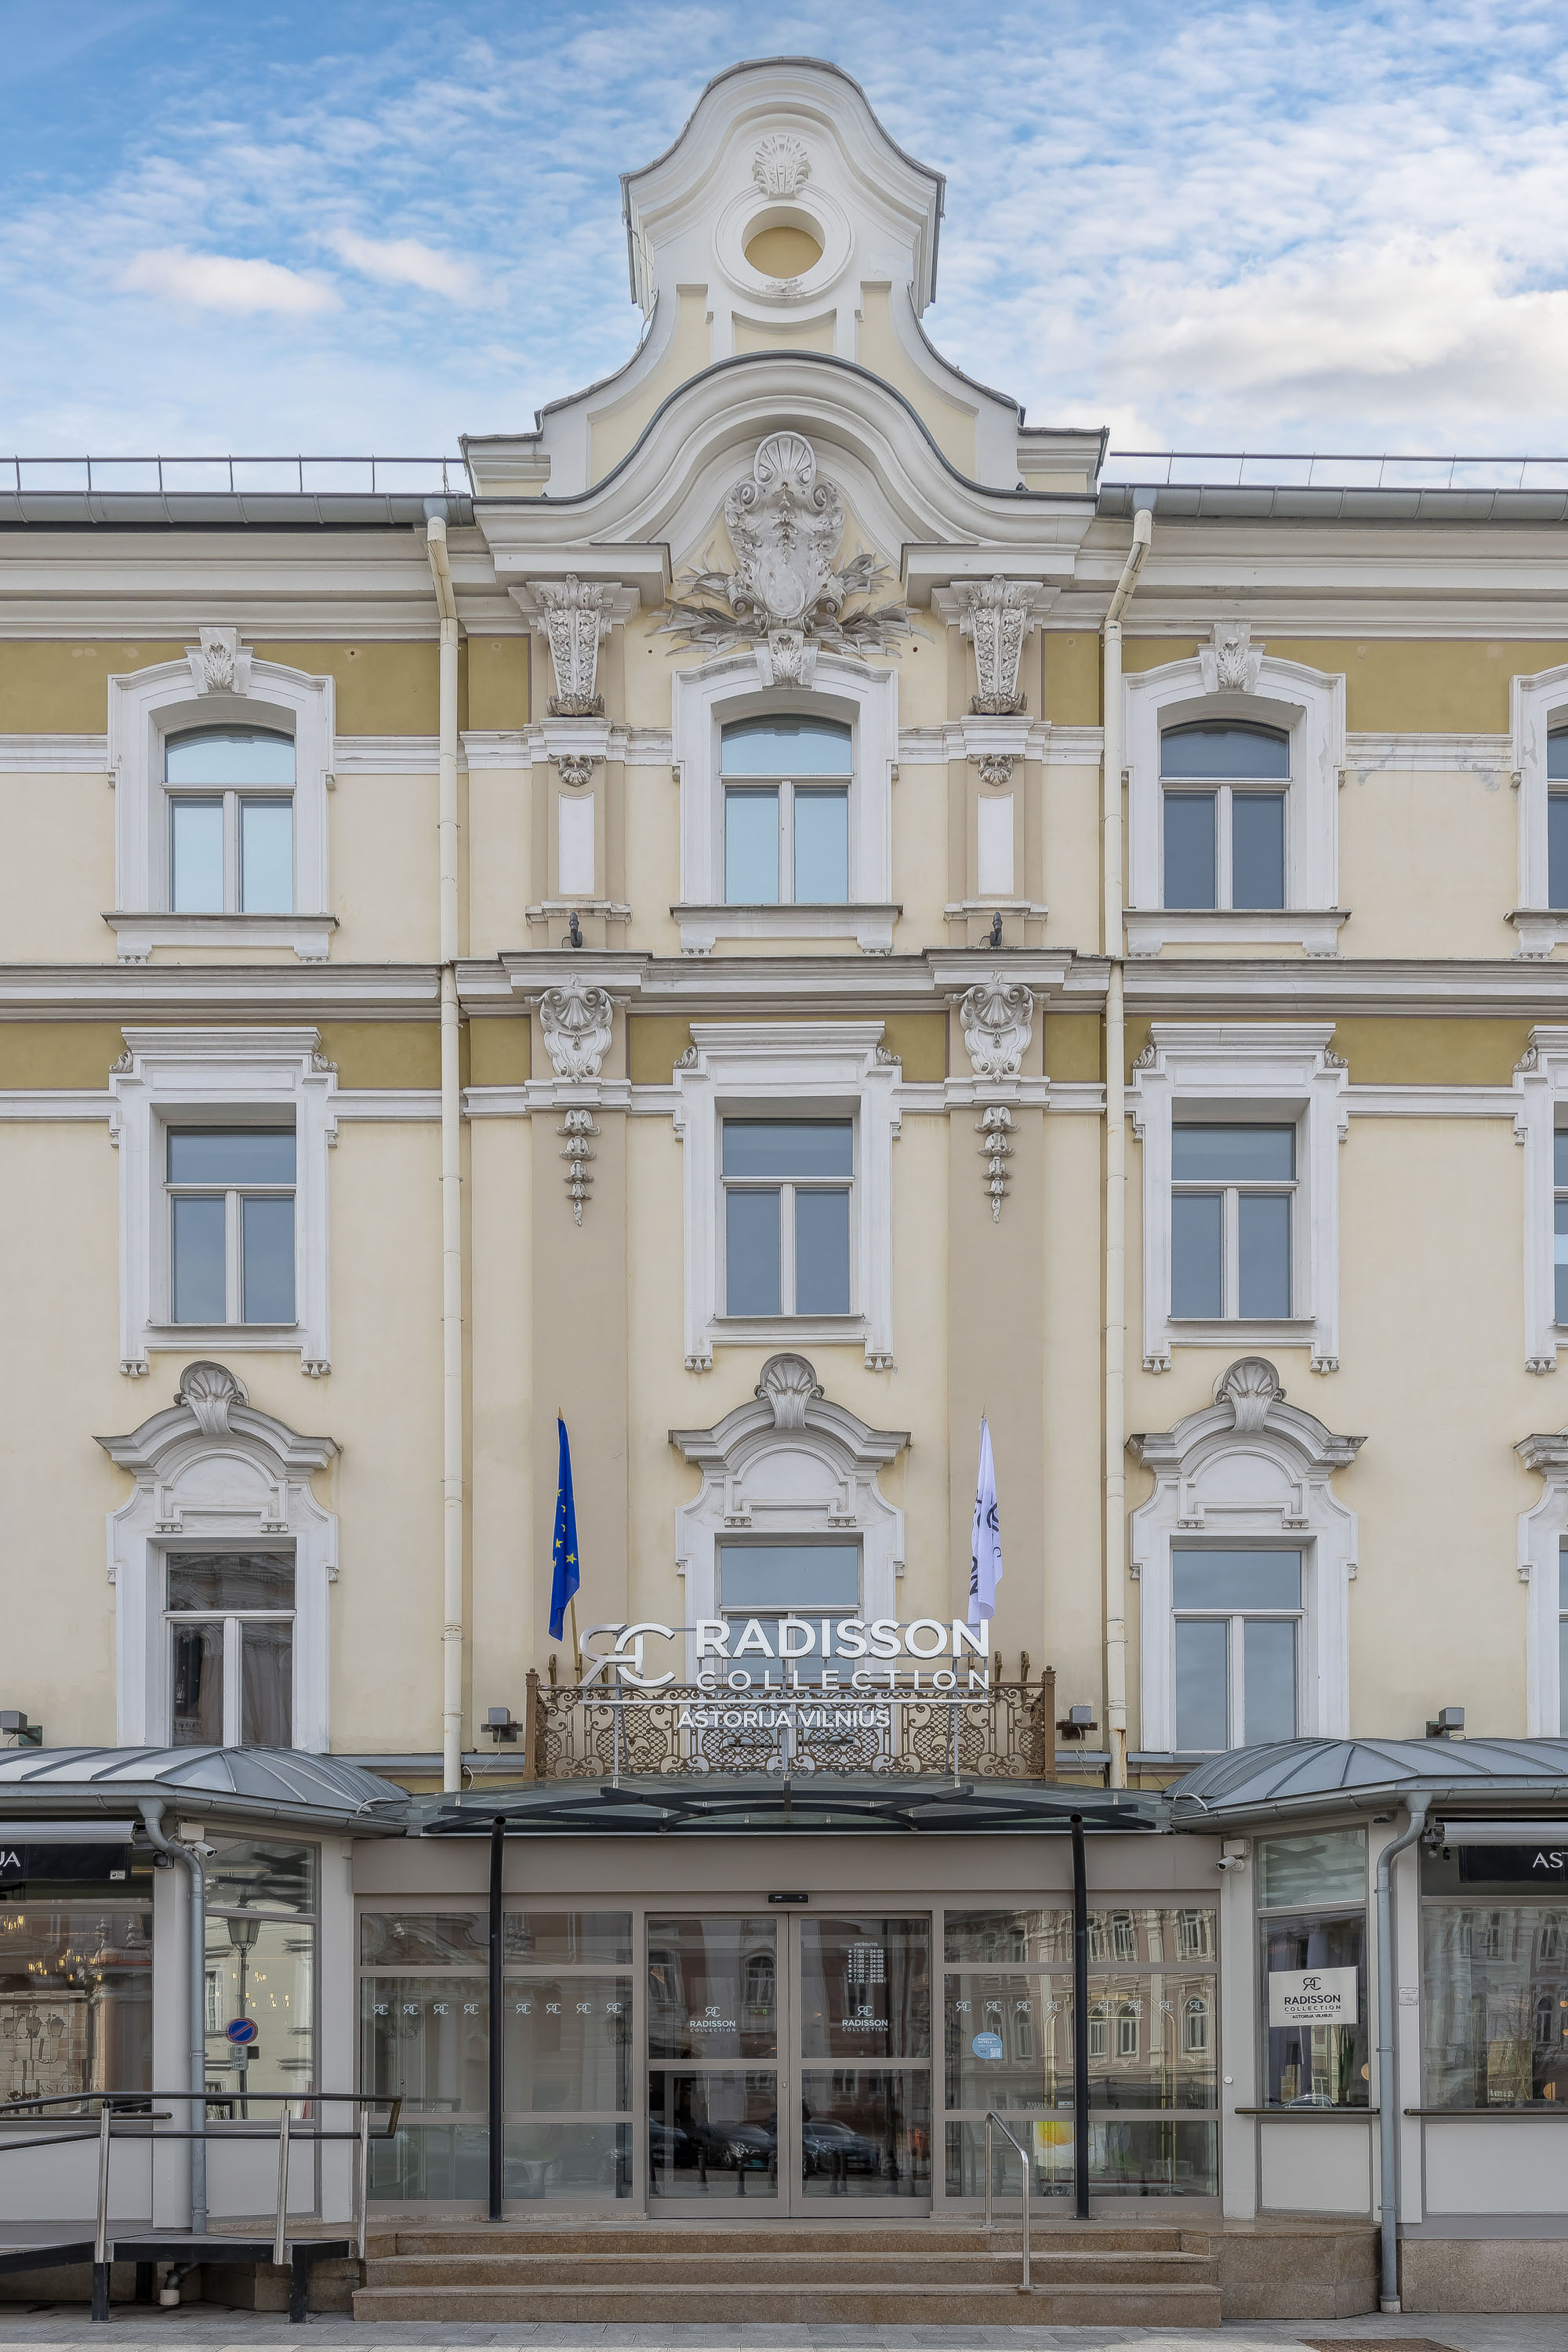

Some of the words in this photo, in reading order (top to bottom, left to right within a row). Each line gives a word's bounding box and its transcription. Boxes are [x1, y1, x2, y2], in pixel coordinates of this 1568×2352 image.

[696, 1618, 989, 1660] RADISSON
[696, 1669, 989, 1692] COLLECTION
[677, 1710, 792, 1728] ASTORIJA
[802, 1710, 891, 1728] VILNIUS
[1284, 1994, 1341, 2005] RADISSON
